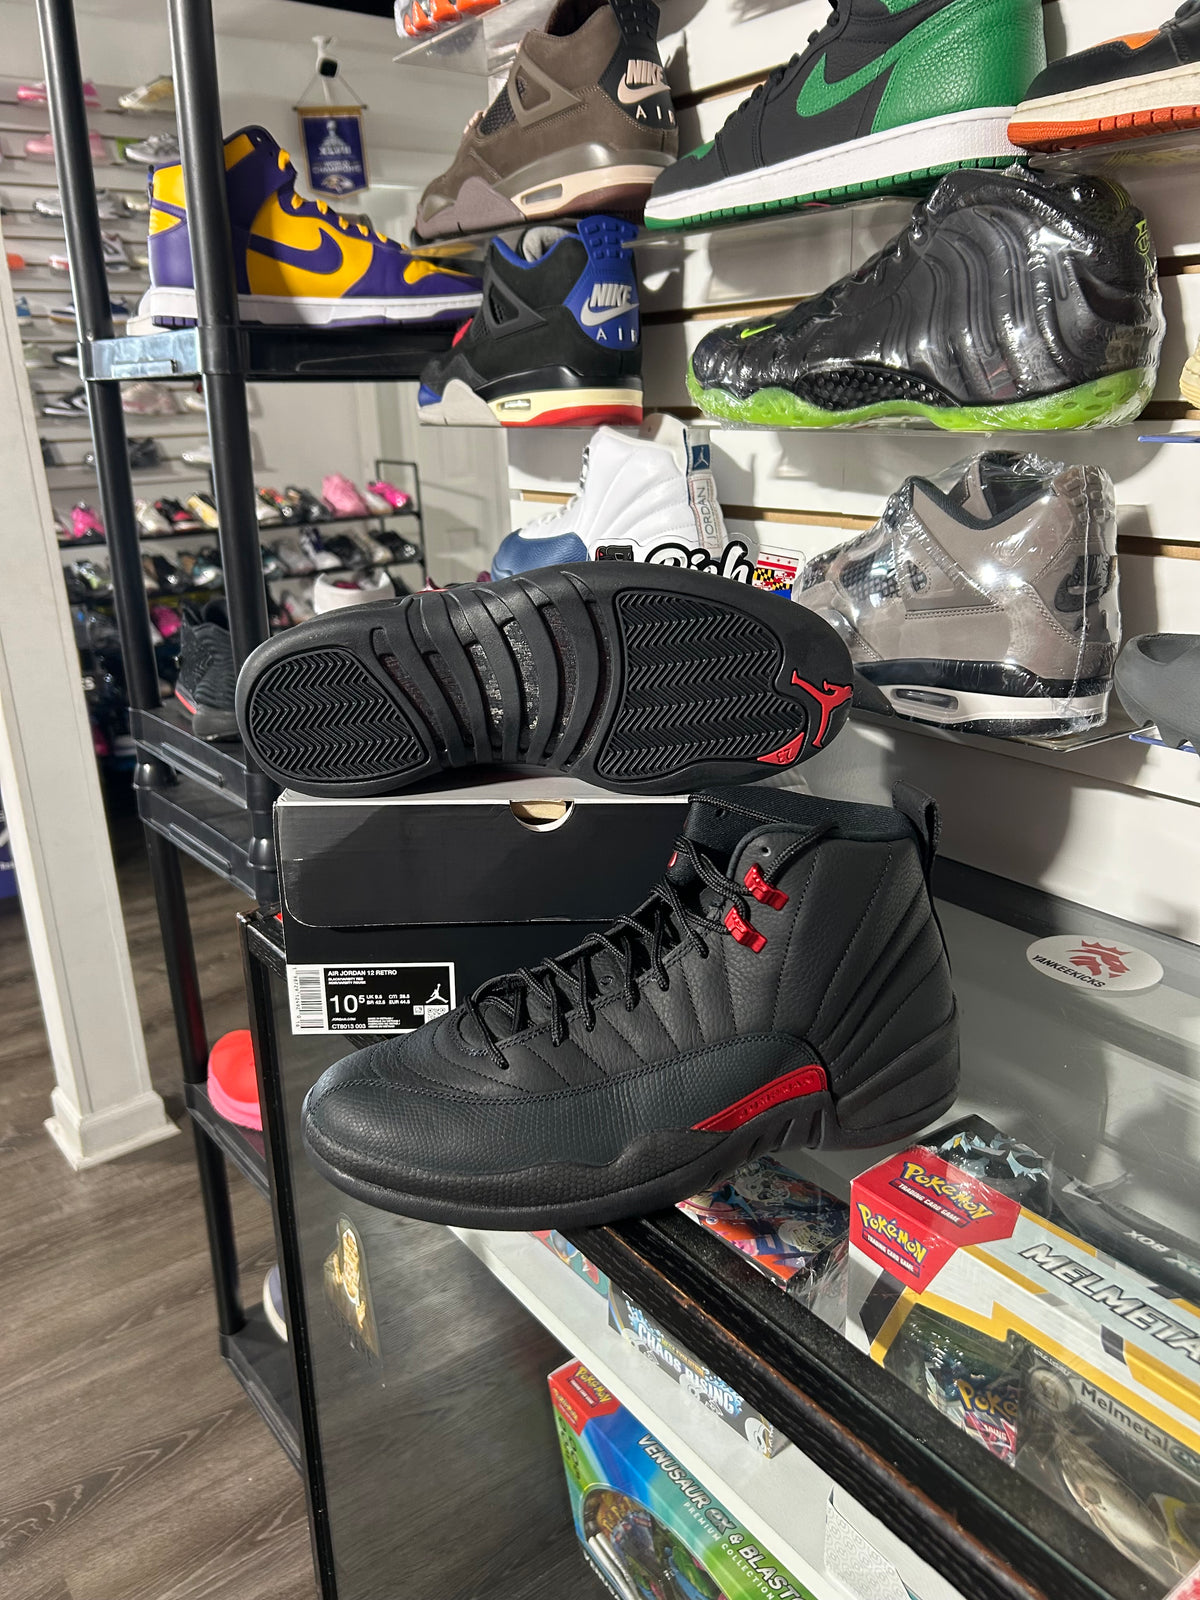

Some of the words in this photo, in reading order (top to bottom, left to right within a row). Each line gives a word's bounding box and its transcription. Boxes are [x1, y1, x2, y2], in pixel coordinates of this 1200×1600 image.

[626, 59, 664, 85] NIKE
[589, 283, 633, 309] NIKE
[697, 487, 717, 539] JORDAN
[1032, 954, 1106, 988] YANKEEKICKS
[898, 1183, 925, 1201] TRADING
[637, 1322, 683, 1373] CHAOS
[1080, 1381, 1169, 1452] Melmetal
[637, 1432, 712, 1509] VENUSAUR
[738, 1544, 806, 1600] BLAST
[682, 1502, 721, 1542] PREMIUM
[721, 1543, 776, 1600] COLLECTION
